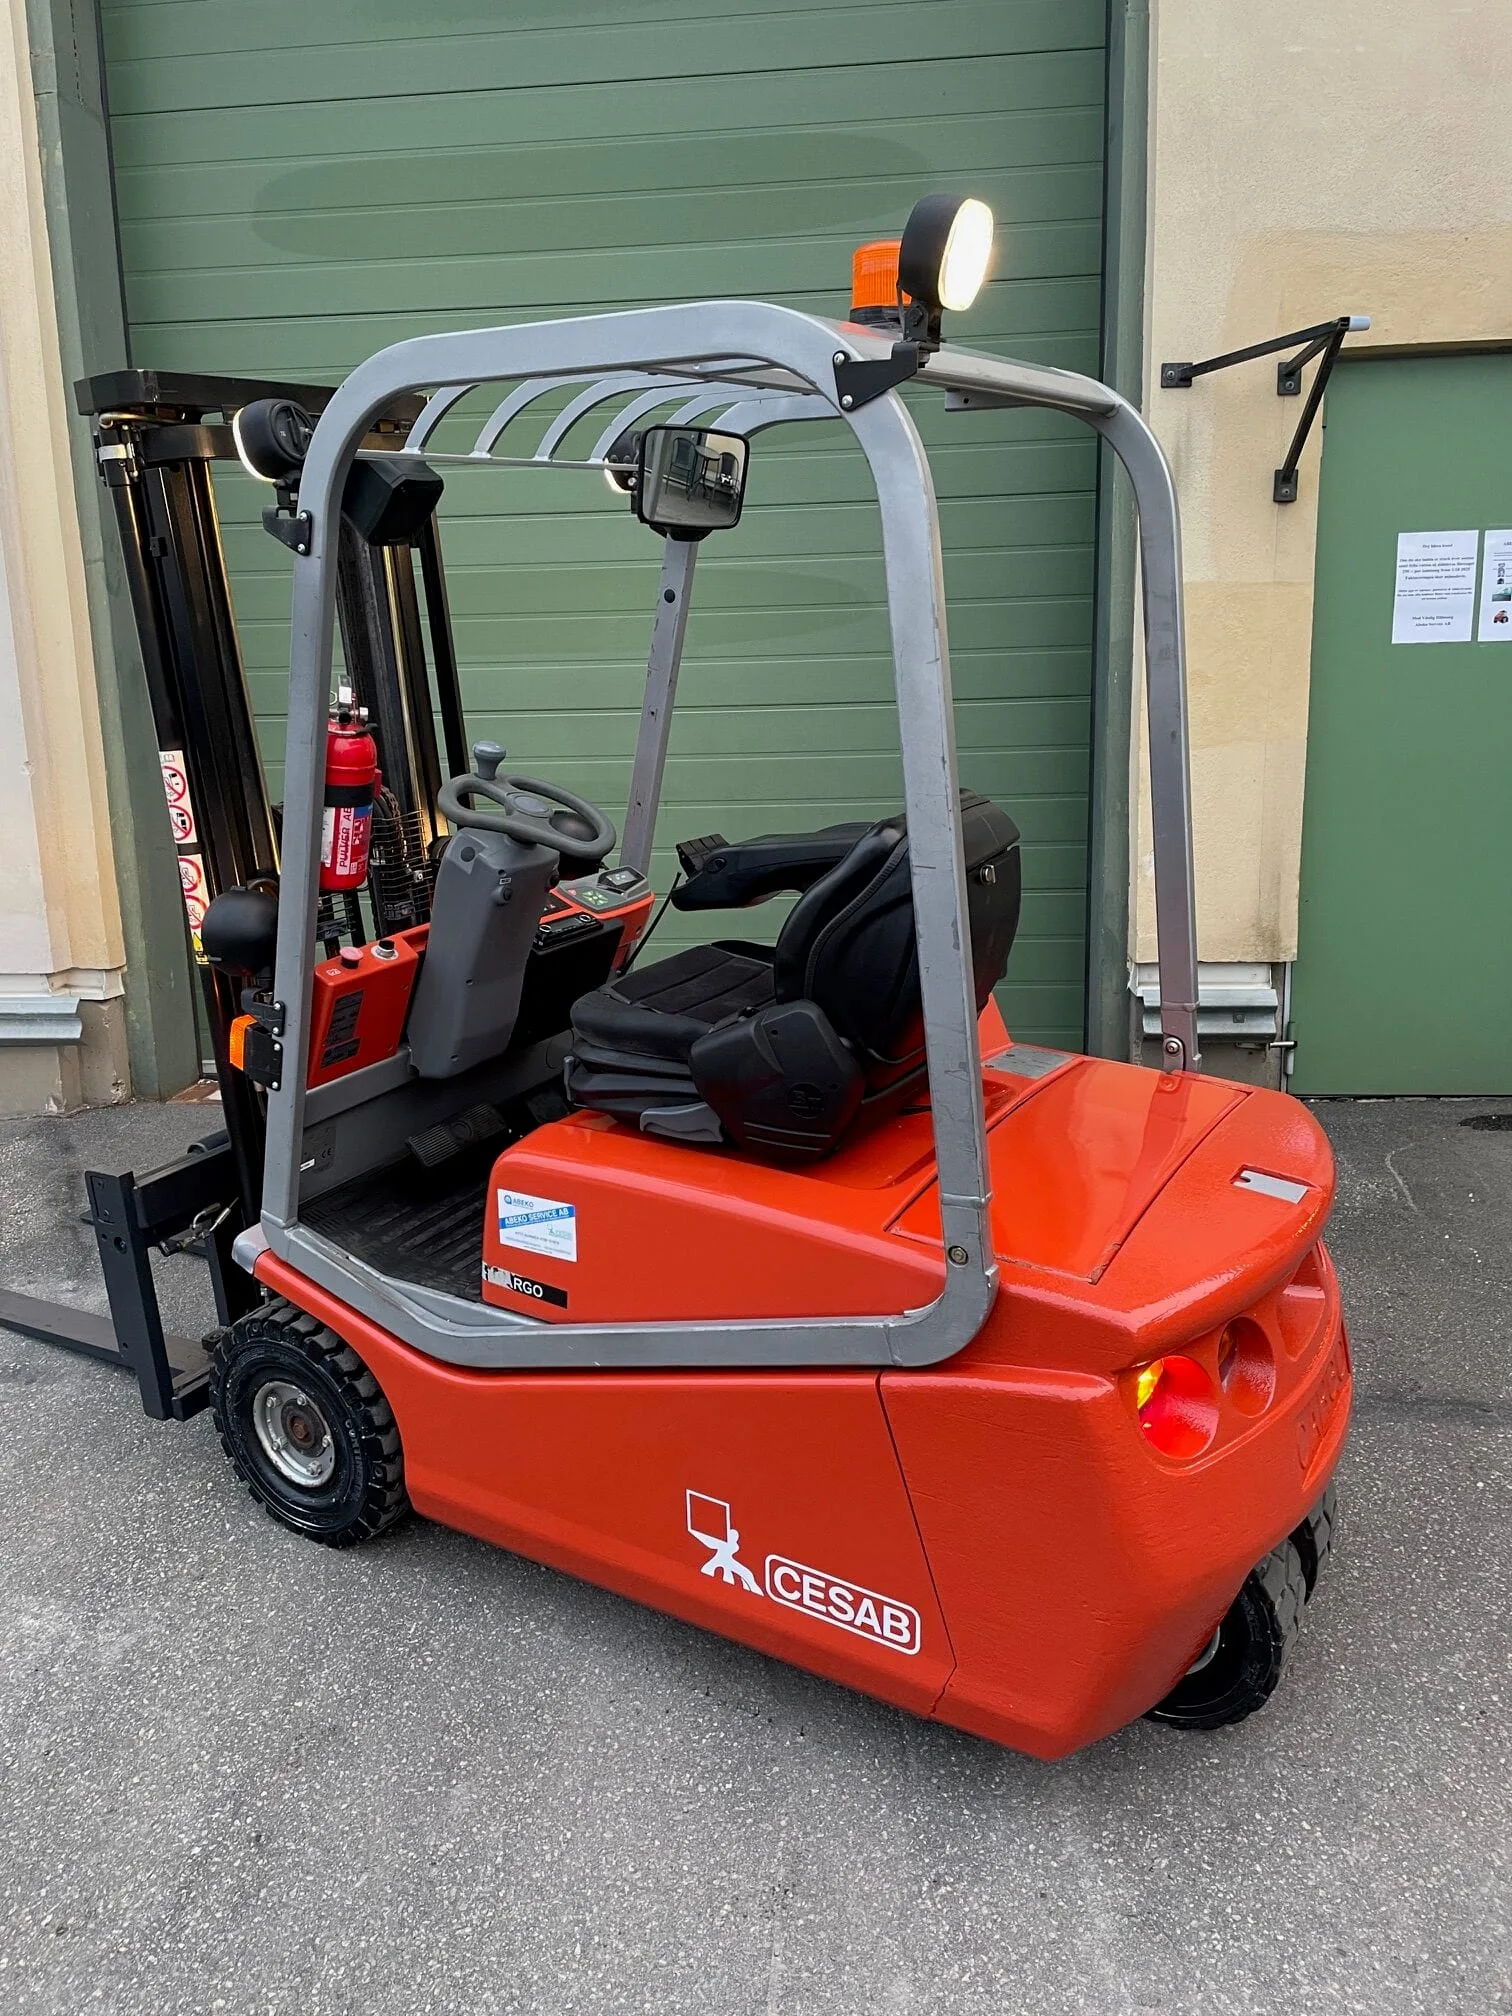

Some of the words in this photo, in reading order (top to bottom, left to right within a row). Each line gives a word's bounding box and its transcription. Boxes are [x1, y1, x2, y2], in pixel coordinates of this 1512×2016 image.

[513, 1198, 534, 1208] ABEKO
[505, 1215, 528, 1225] ABEKO
[528, 1210, 558, 1221] SERVICE
[559, 1207, 569, 1216] AB
[773, 1566, 911, 1644] CESAB
